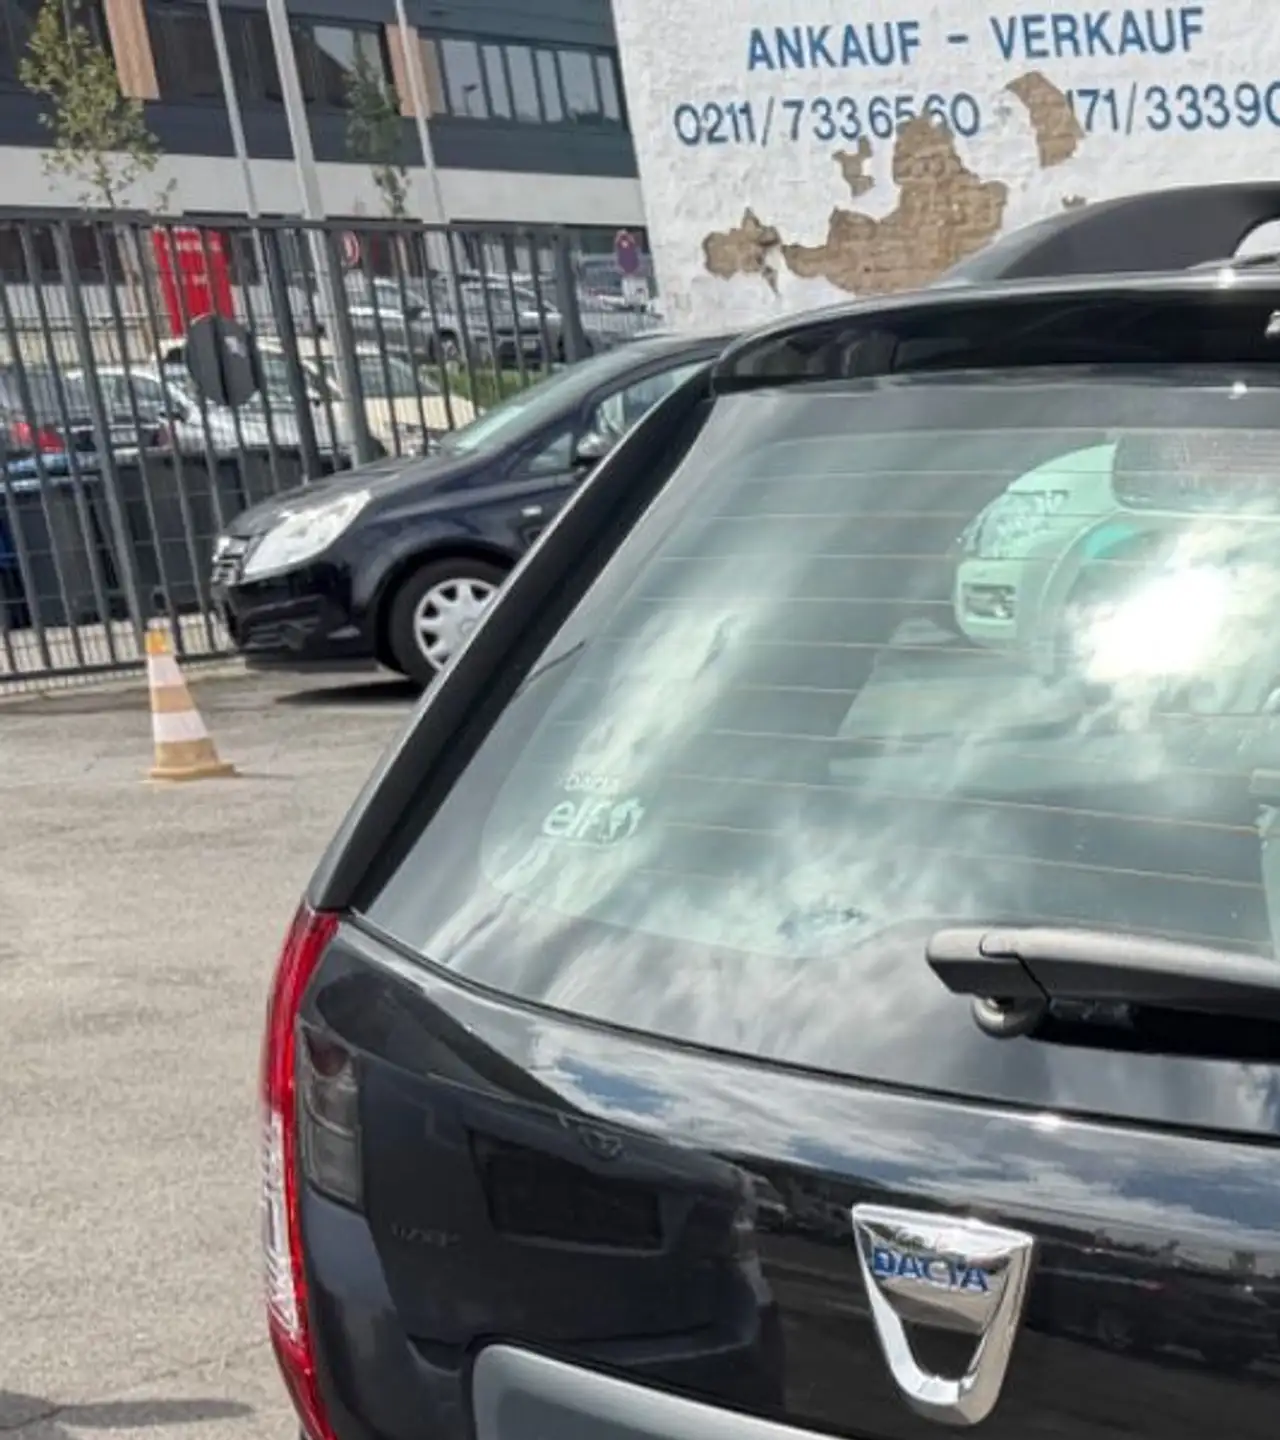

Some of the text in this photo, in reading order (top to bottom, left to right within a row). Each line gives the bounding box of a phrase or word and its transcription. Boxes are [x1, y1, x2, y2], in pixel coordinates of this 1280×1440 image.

[748, 7, 1205, 70] ANKAUF - VERKAUF
[873, 1248, 989, 1293] DACIA
